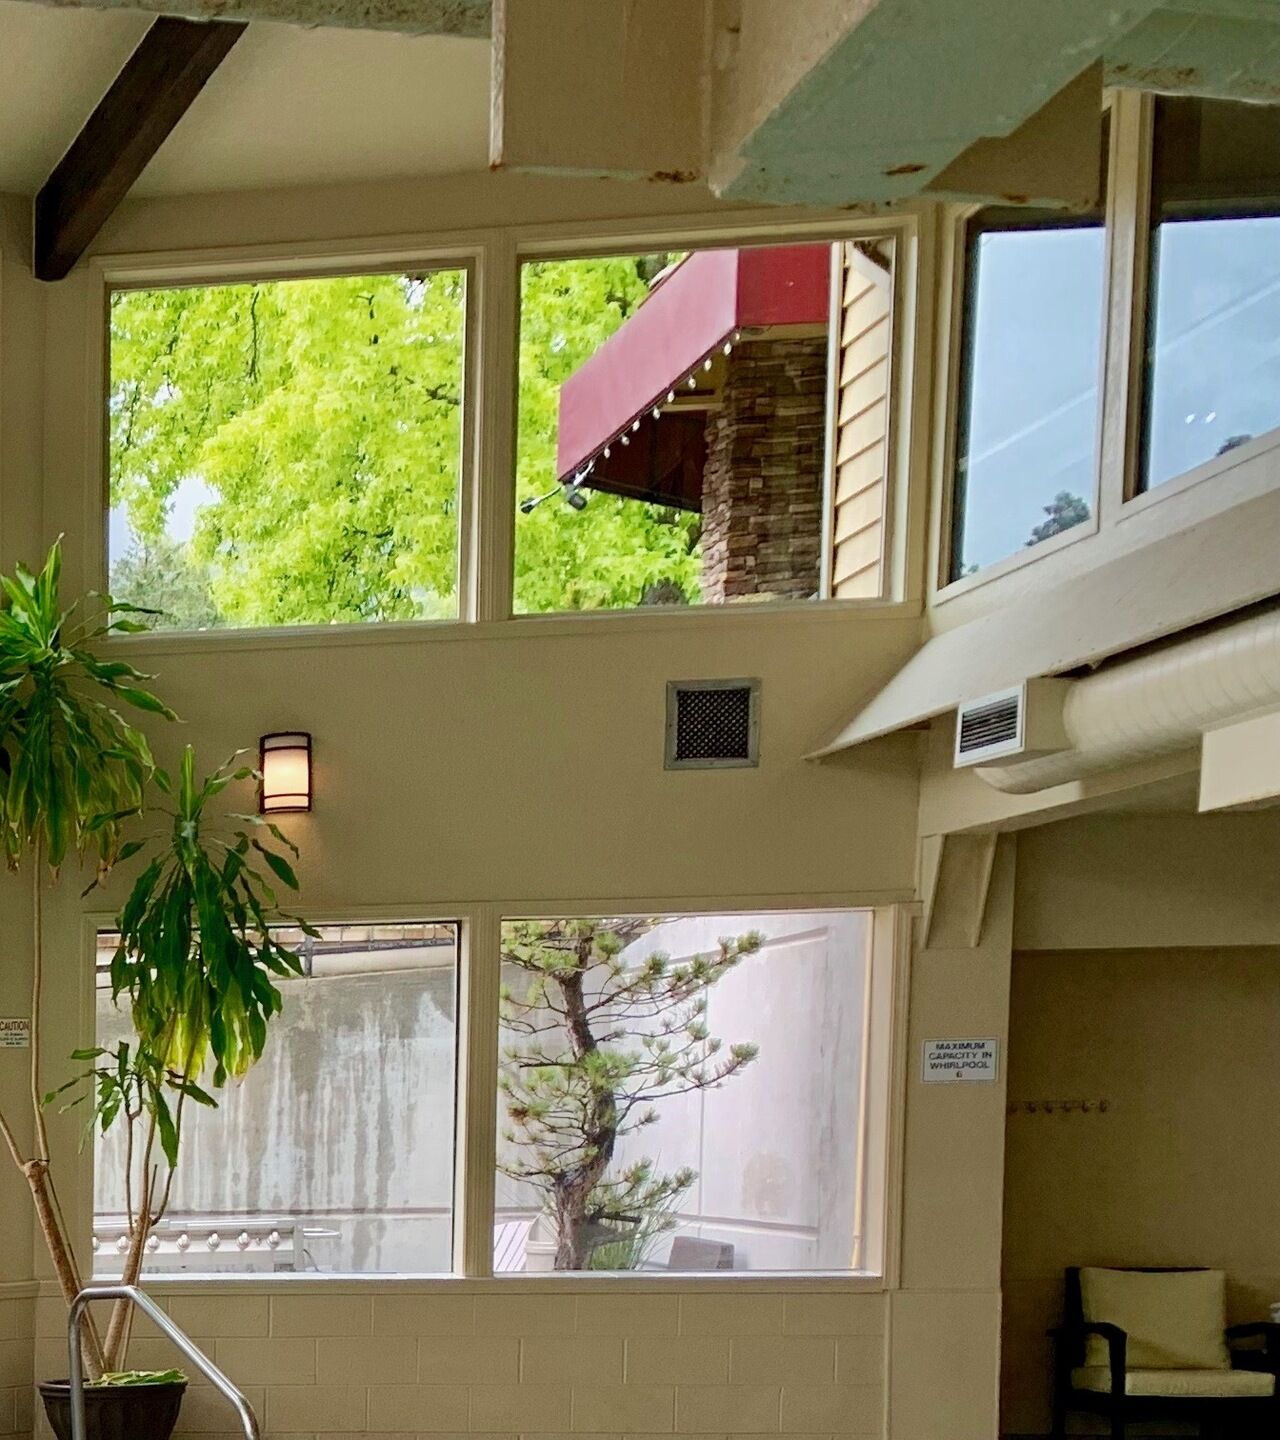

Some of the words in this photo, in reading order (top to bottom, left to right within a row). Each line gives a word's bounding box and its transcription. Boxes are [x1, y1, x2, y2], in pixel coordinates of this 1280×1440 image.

[935, 1042, 985, 1050] MAXIMUM
[928, 1051, 978, 1060] CAPACITY
[982, 1051, 992, 1059] IN
[929, 1061, 990, 1070] WHIRLPOOL
